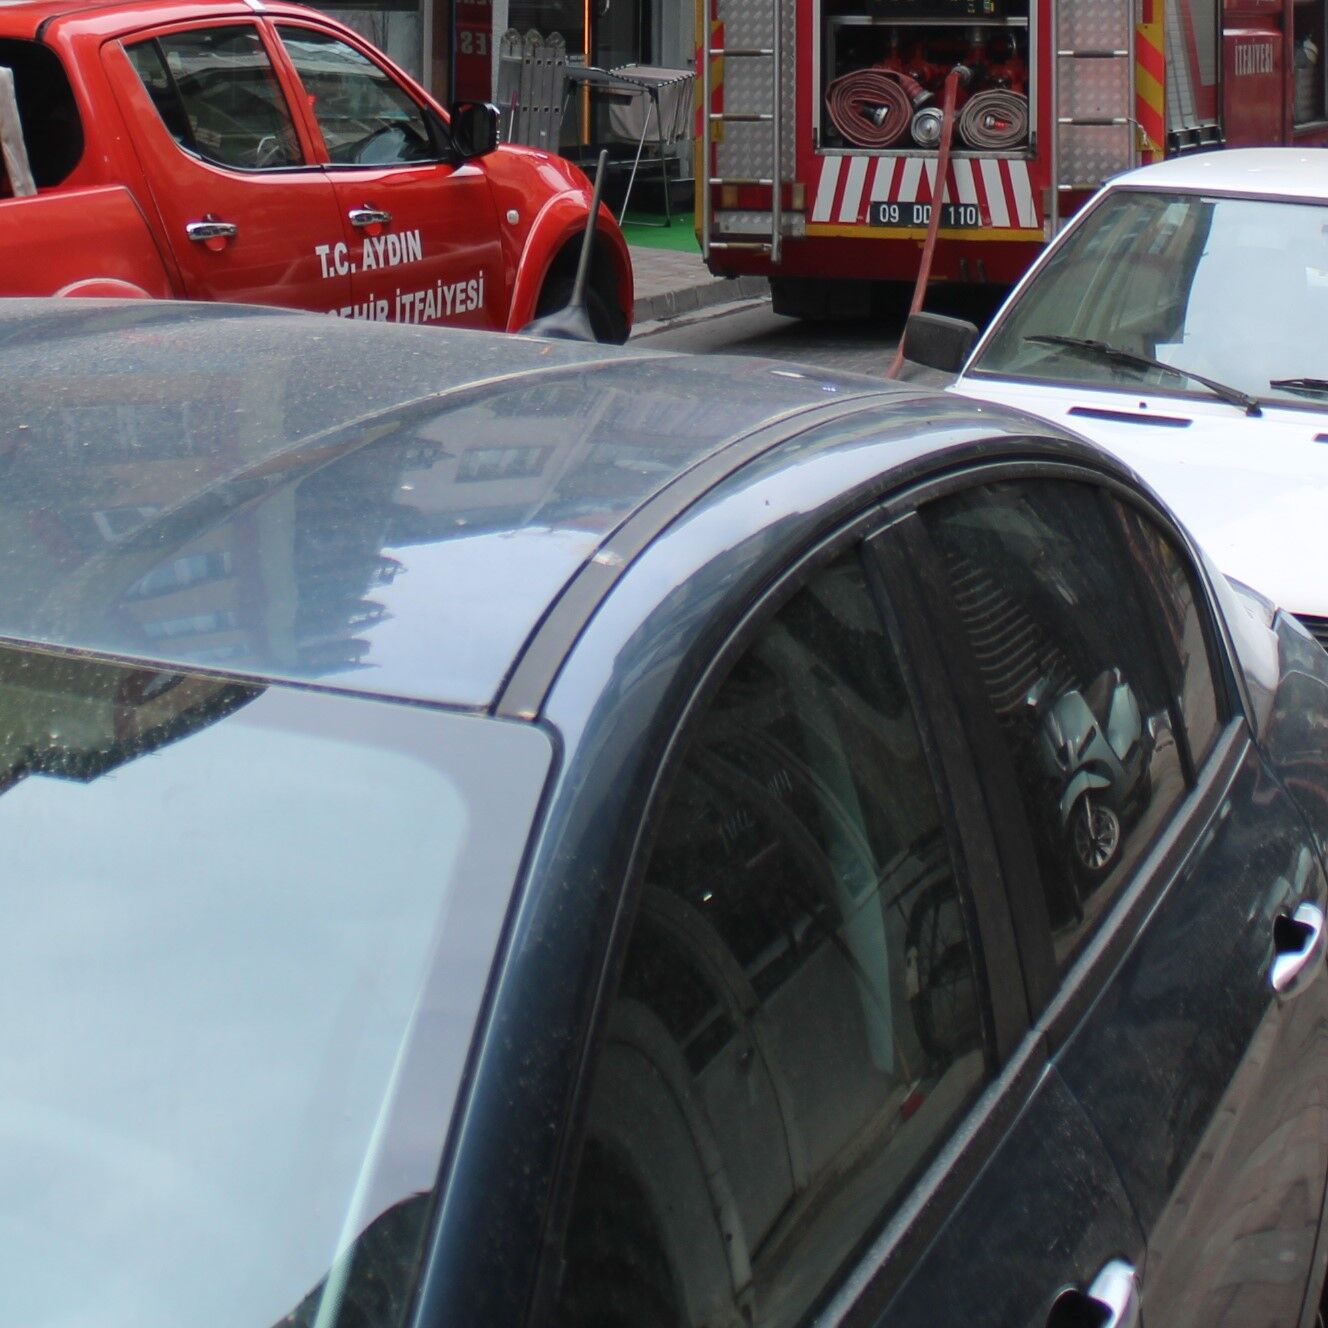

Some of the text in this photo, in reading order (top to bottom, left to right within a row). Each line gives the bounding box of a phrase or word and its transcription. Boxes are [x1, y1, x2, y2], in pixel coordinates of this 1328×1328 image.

[879, 204, 900, 223] 09
[949, 206, 976, 225] 110
[315, 230, 422, 279] T.C. AYDIN
[395, 270, 484, 324] İTFAİYESİ
